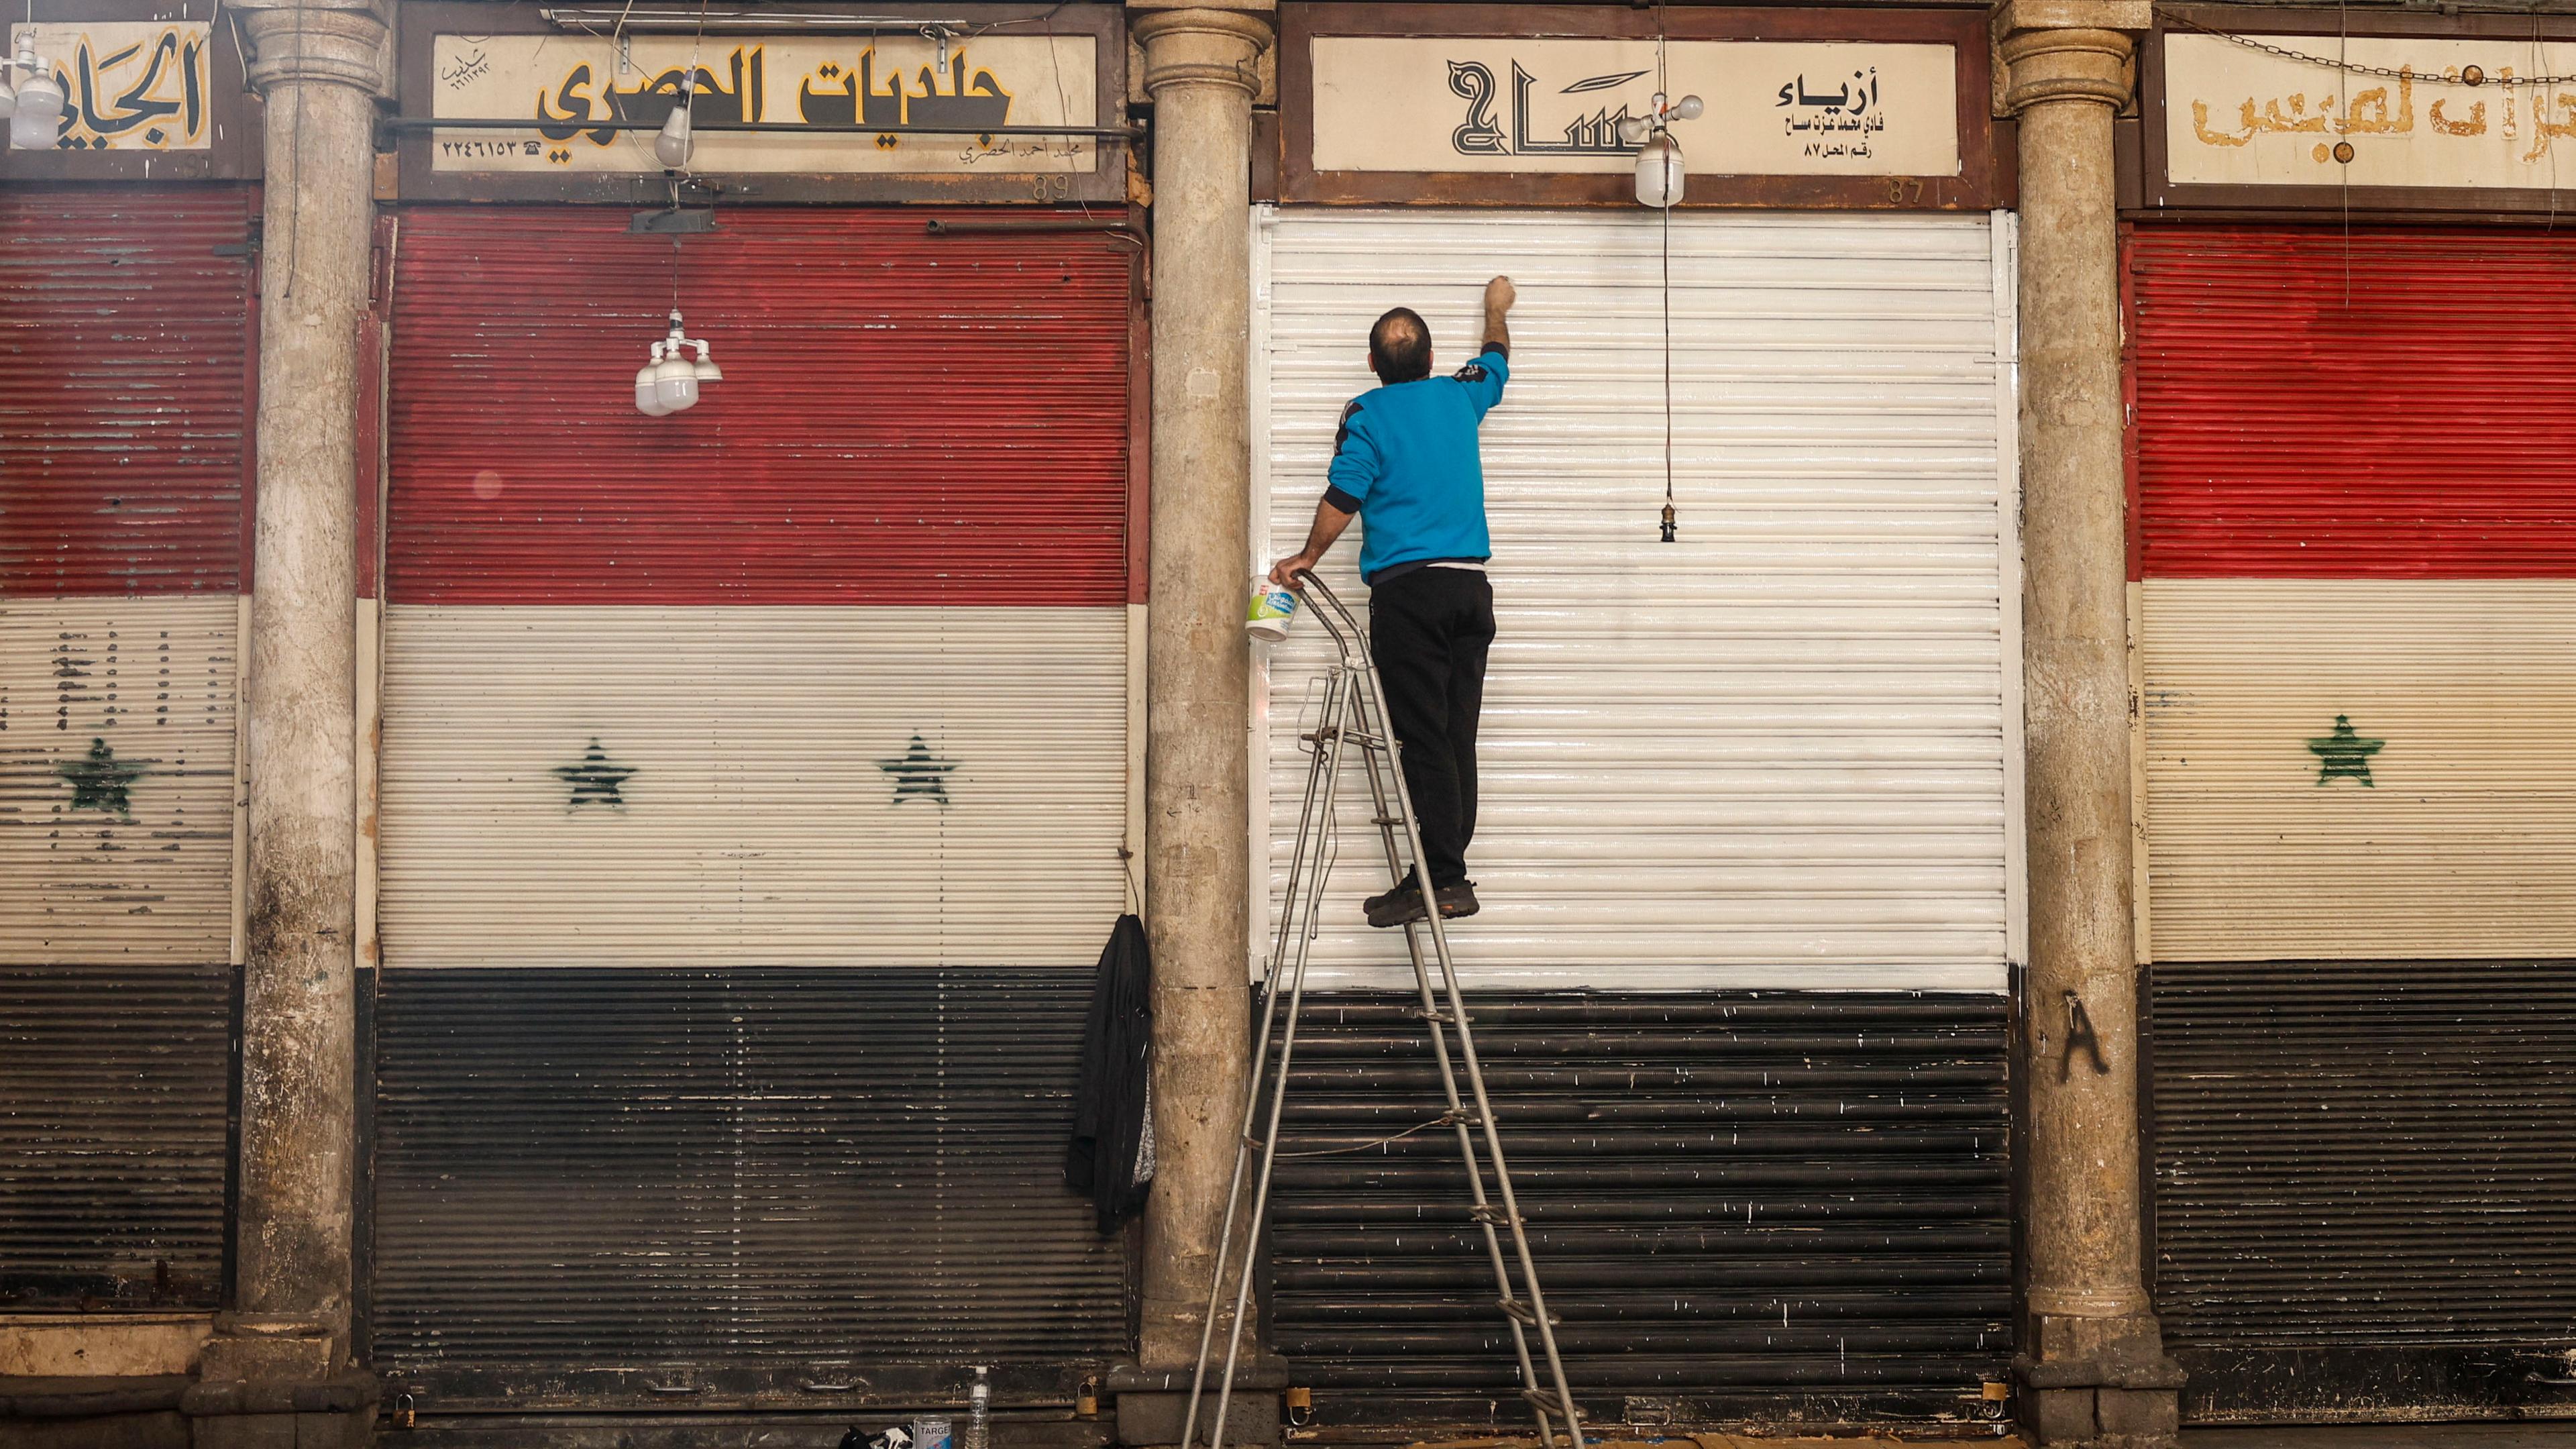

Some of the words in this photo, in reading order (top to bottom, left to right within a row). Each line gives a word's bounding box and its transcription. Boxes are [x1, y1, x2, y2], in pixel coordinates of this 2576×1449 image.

[796, 46, 1014, 152] جلديات
[1776, 66, 1878, 115] أزياء
[536, 42, 766, 167] الحصري
[1784, 113, 1811, 137] مساح
[1813, 115, 1835, 136] عزت
[1838, 116, 1861, 131] محمد
[1863, 112, 1885, 139] فادي
[442, 141, 517, 158] ٢٢٤٦١٥٣
[959, 138, 1016, 165] الحصري
[1019, 136, 1049, 158] أحمد
[1053, 144, 1083, 158] محمد
[1804, 143, 1821, 157] ٨٧
[1821, 144, 1848, 158] المحل
[1850, 142, 1872, 160] رقم
[1032, 174, 1069, 200] 89
[1887, 178, 1924, 204] 87
